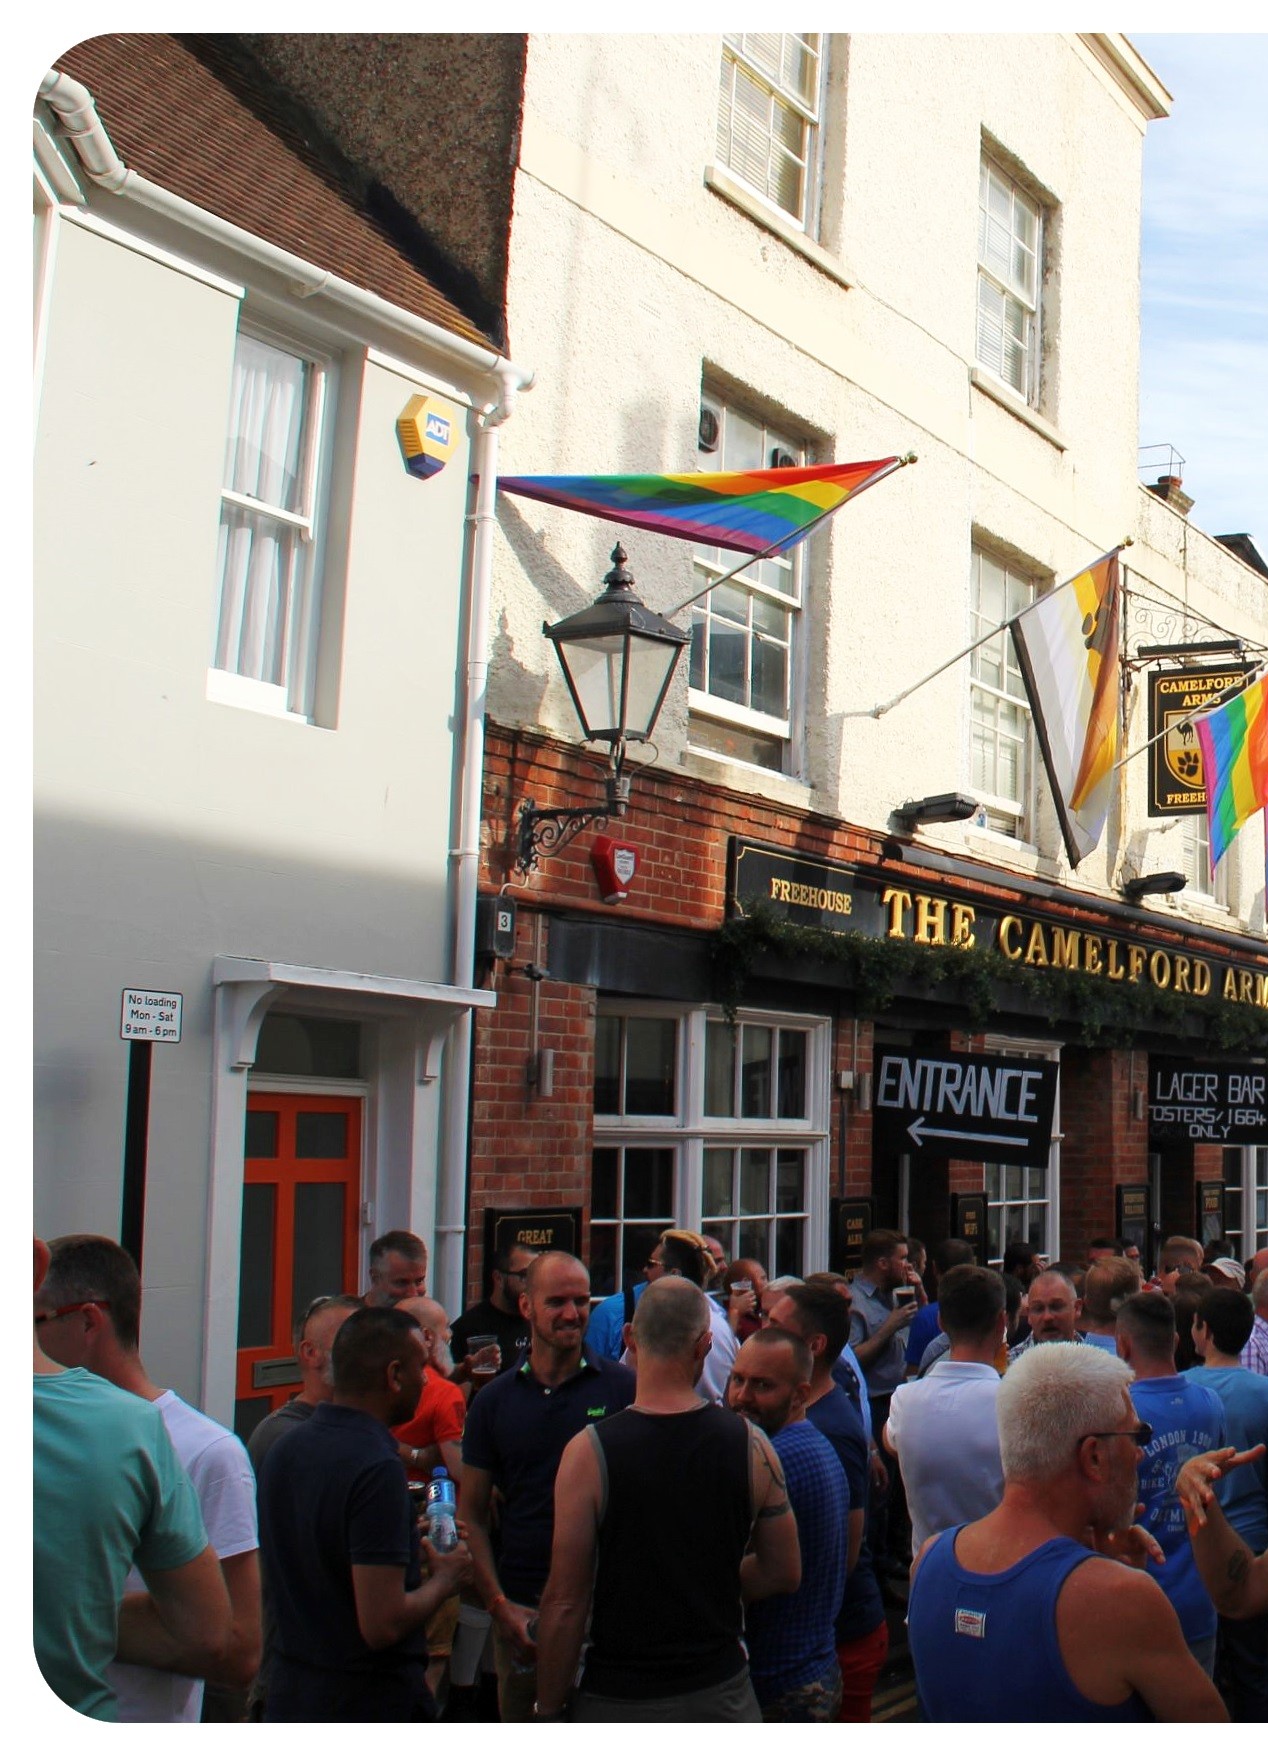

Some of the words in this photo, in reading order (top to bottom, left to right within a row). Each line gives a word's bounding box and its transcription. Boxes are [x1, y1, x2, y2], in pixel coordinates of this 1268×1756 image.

[426, 419, 450, 441] ADT
[1159, 676, 1244, 693] CAMELFORD
[1166, 792, 1209, 804] FREEH
[500, 914, 508, 928] 3
[770, 877, 852, 915] FREEHOUSE
[881, 884, 976, 949] THE
[999, 914, 1212, 997] CAMELFORD
[128, 994, 142, 1005] No
[144, 996, 177, 1009] loading
[130, 1009, 150, 1020] Mon
[158, 1011, 173, 1021] Sat
[876, 1056, 1043, 1123] ENTRANCE
[1156, 1071, 1219, 1103] LAGER
[1227, 1074, 1266, 1105] BAR
[1188, 1124, 1232, 1139] ONLY
[517, 1229, 553, 1245] GREAT
[1143, 1430, 1187, 1458] LONDON
